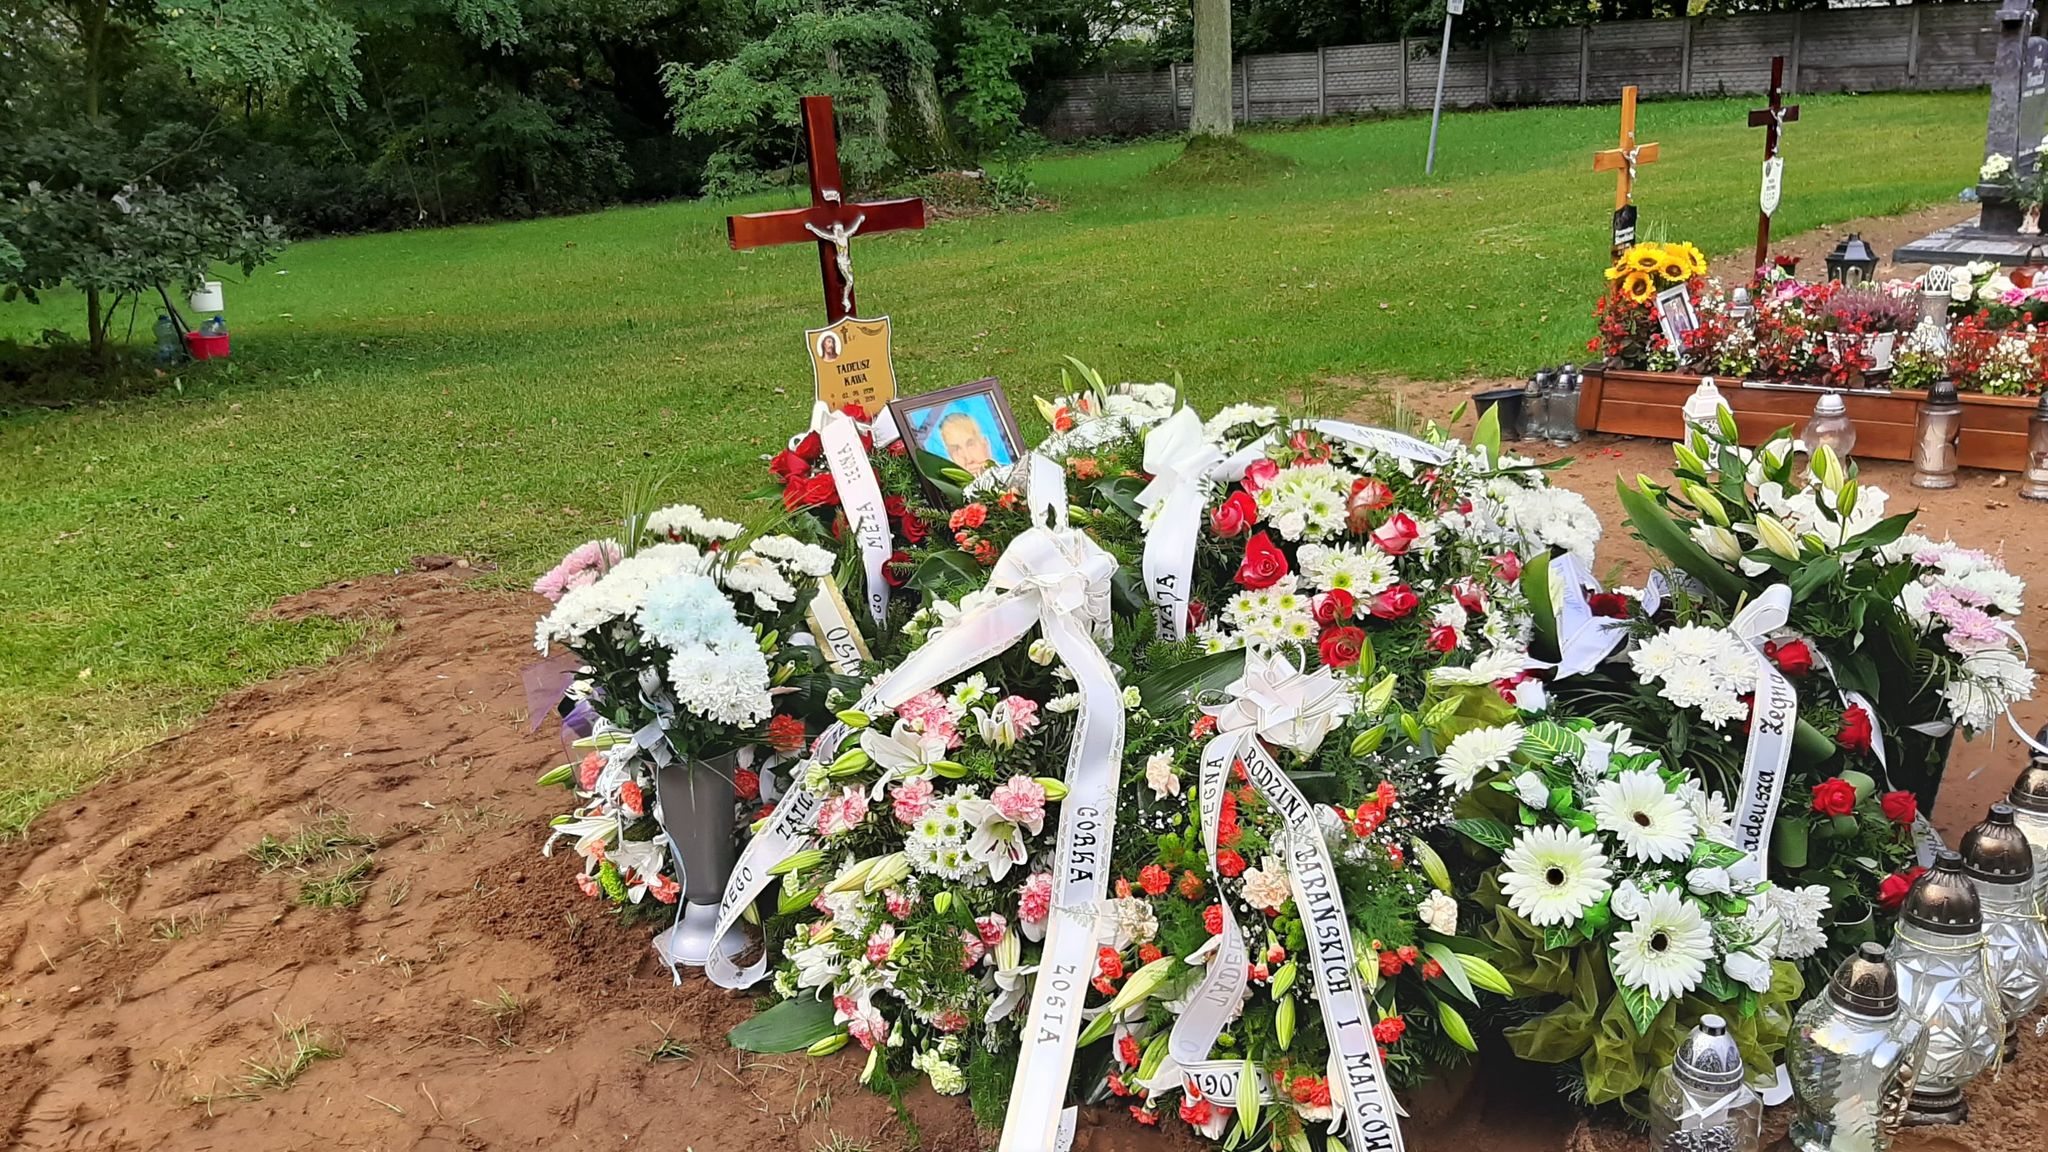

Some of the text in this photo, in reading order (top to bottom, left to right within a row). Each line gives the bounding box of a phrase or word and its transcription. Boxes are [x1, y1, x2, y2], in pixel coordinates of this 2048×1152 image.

[836, 359, 870, 375] TADEUSZ
[844, 373, 868, 387] KAWA
[1739, 769, 1776, 862] adeusza
[1244, 747, 1308, 831] RODZINA
[1295, 844, 1353, 995] BARAŃSKICH
[1337, 1016, 1362, 1029] I
[1037, 965, 1077, 1044] ZOSIA
